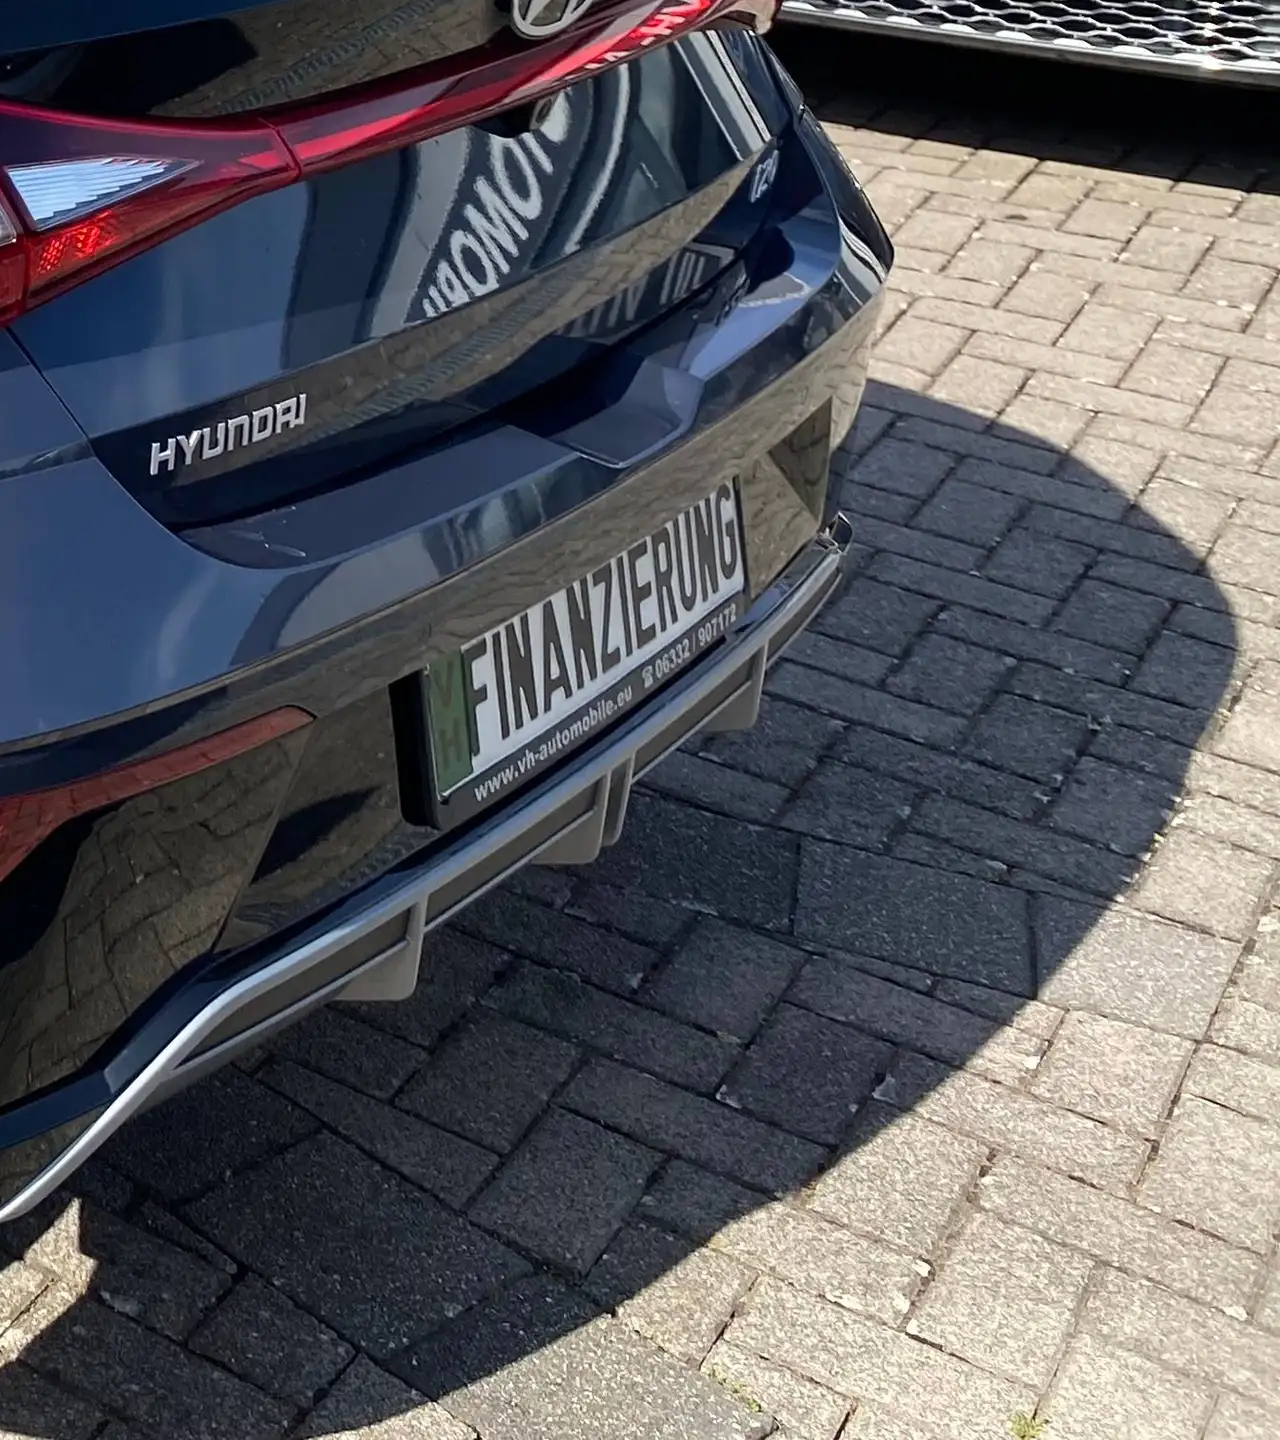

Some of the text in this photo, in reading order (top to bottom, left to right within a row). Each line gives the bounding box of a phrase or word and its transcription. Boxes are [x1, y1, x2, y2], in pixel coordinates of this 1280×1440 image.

[149, 393, 308, 476] HYUNDAI
[461, 485, 739, 759] FINANZIERUNG
[654, 639, 691, 682] 06332
[698, 603, 738, 647] 907172
[472, 683, 634, 803] www.vh-automobile.eu
